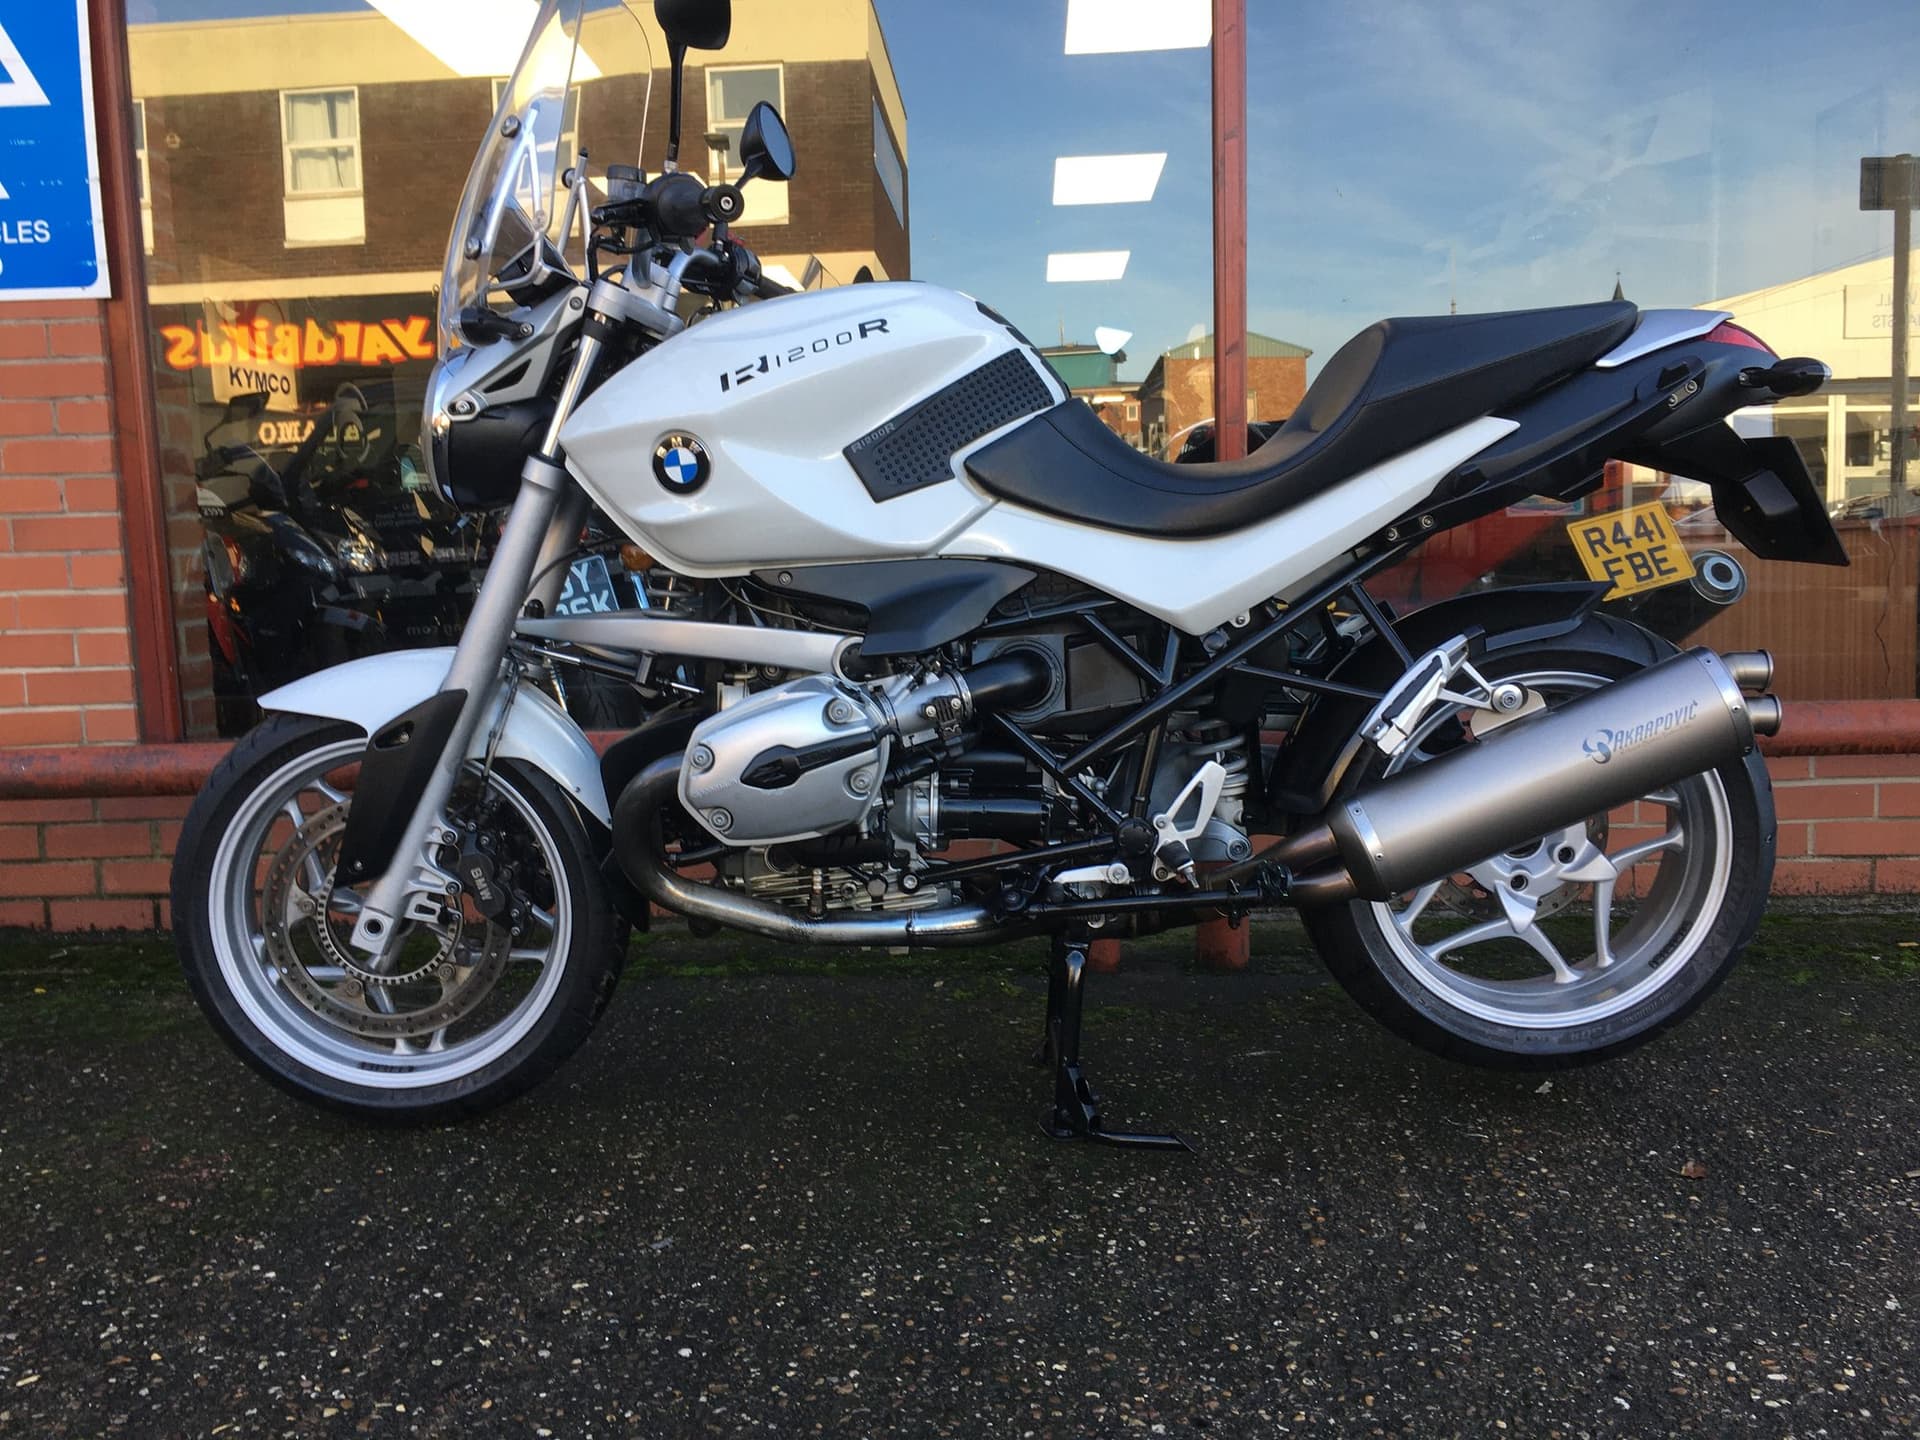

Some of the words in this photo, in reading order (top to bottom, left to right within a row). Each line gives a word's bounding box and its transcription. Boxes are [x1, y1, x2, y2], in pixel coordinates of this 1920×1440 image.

[0, 219, 51, 245] LES
[229, 365, 291, 395] KYMCO
[1582, 511, 1666, 558] R441
[1602, 544, 1678, 589] FBE
[470, 867, 493, 901] BMW
